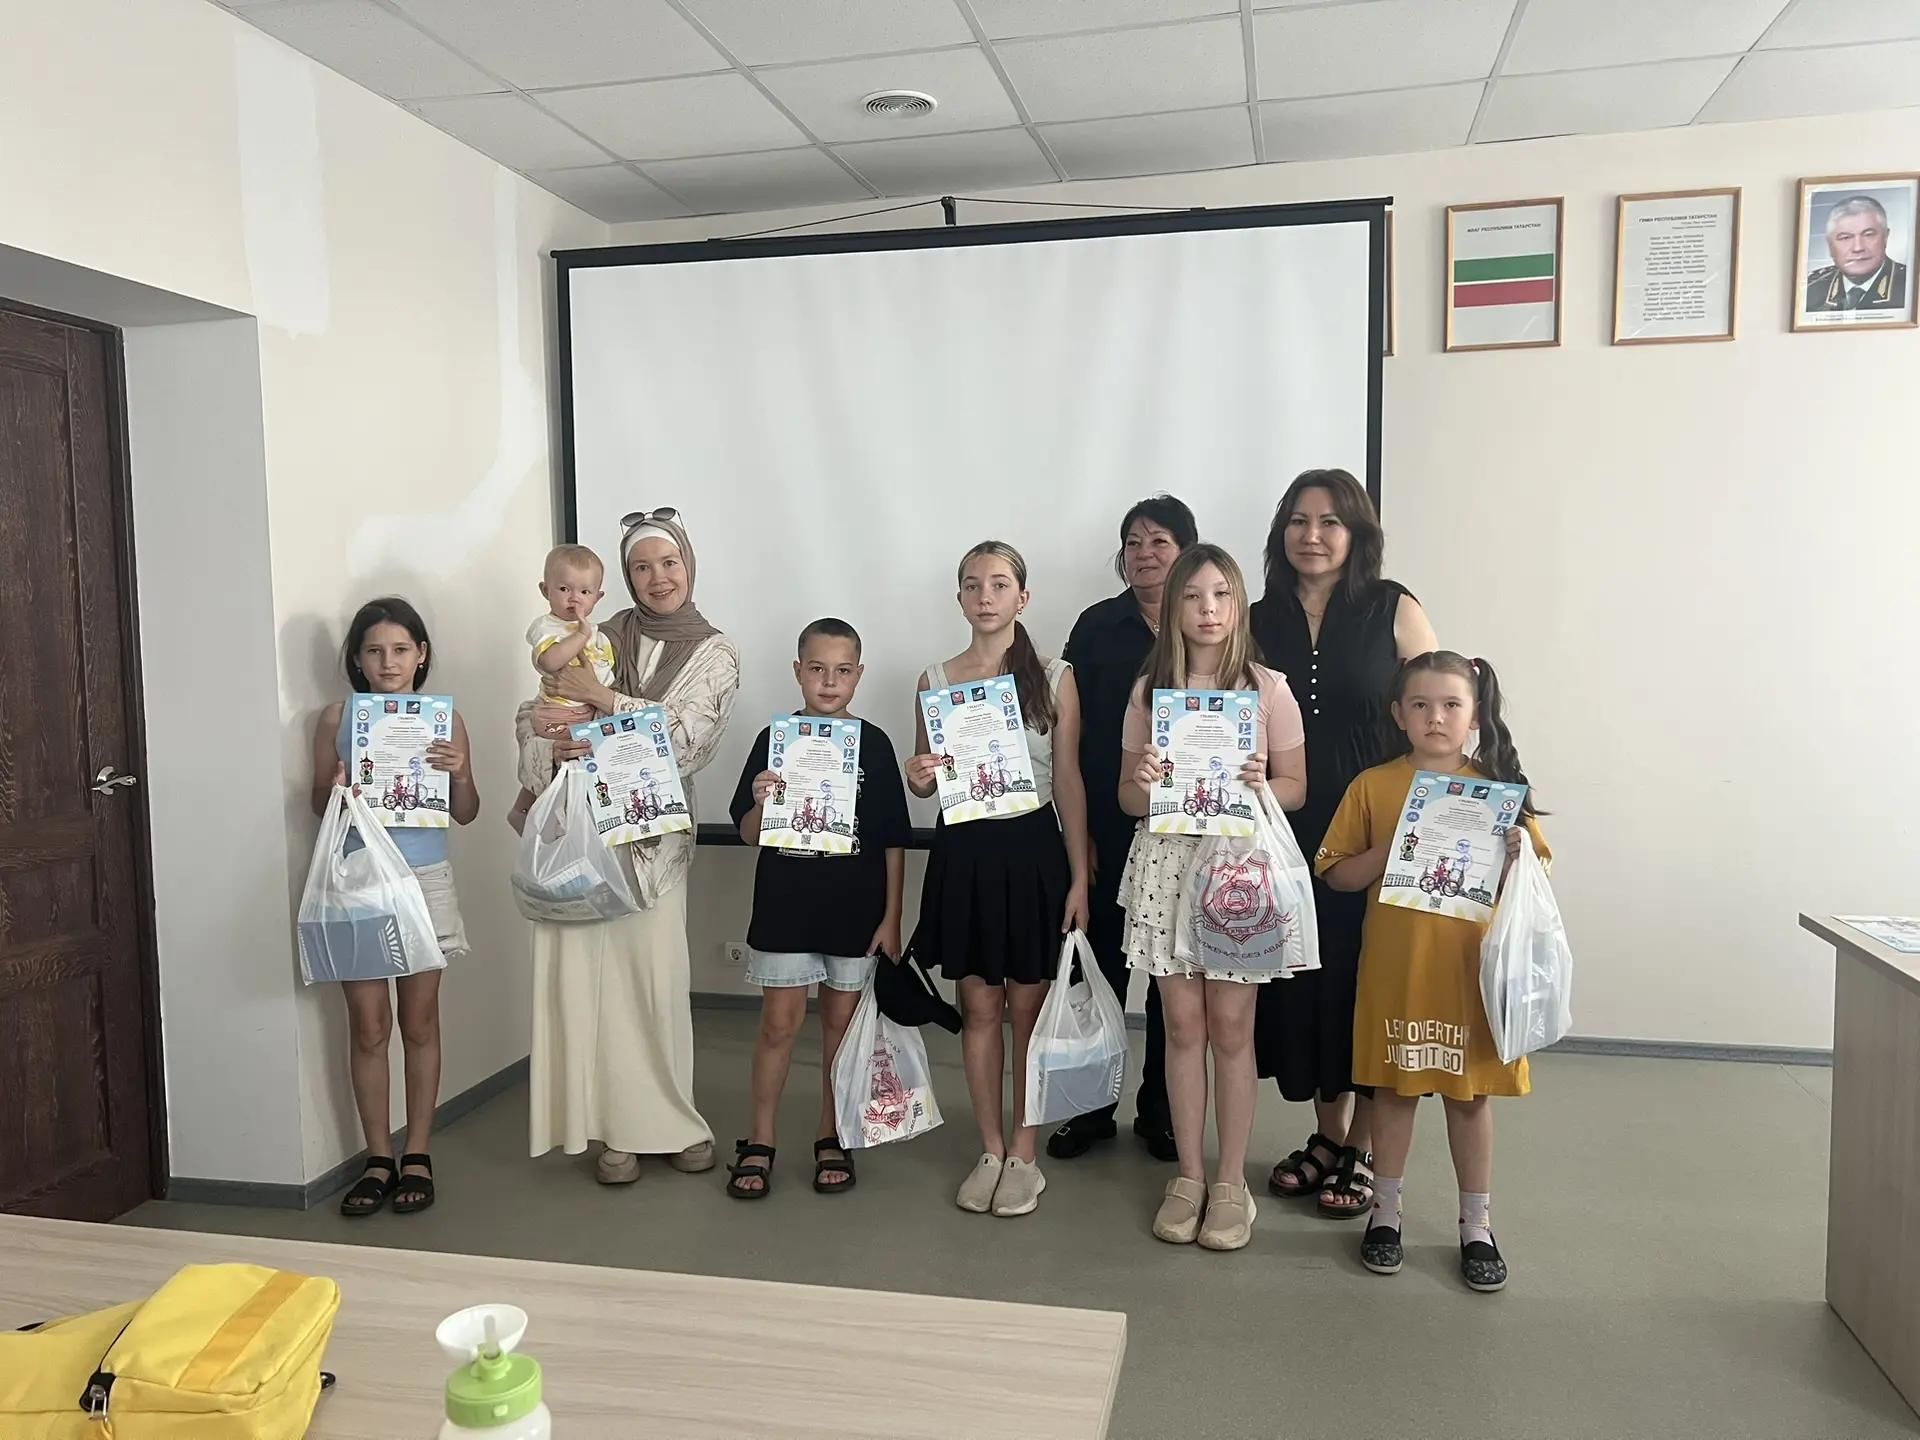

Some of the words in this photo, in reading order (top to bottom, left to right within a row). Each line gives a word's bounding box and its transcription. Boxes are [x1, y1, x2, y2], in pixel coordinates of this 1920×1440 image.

[1384, 1044, 1400, 1063] JU
[1400, 1048, 1422, 1068] LET
[1425, 1046, 1439, 1066] IT
[1442, 1050, 1461, 1073] GO
